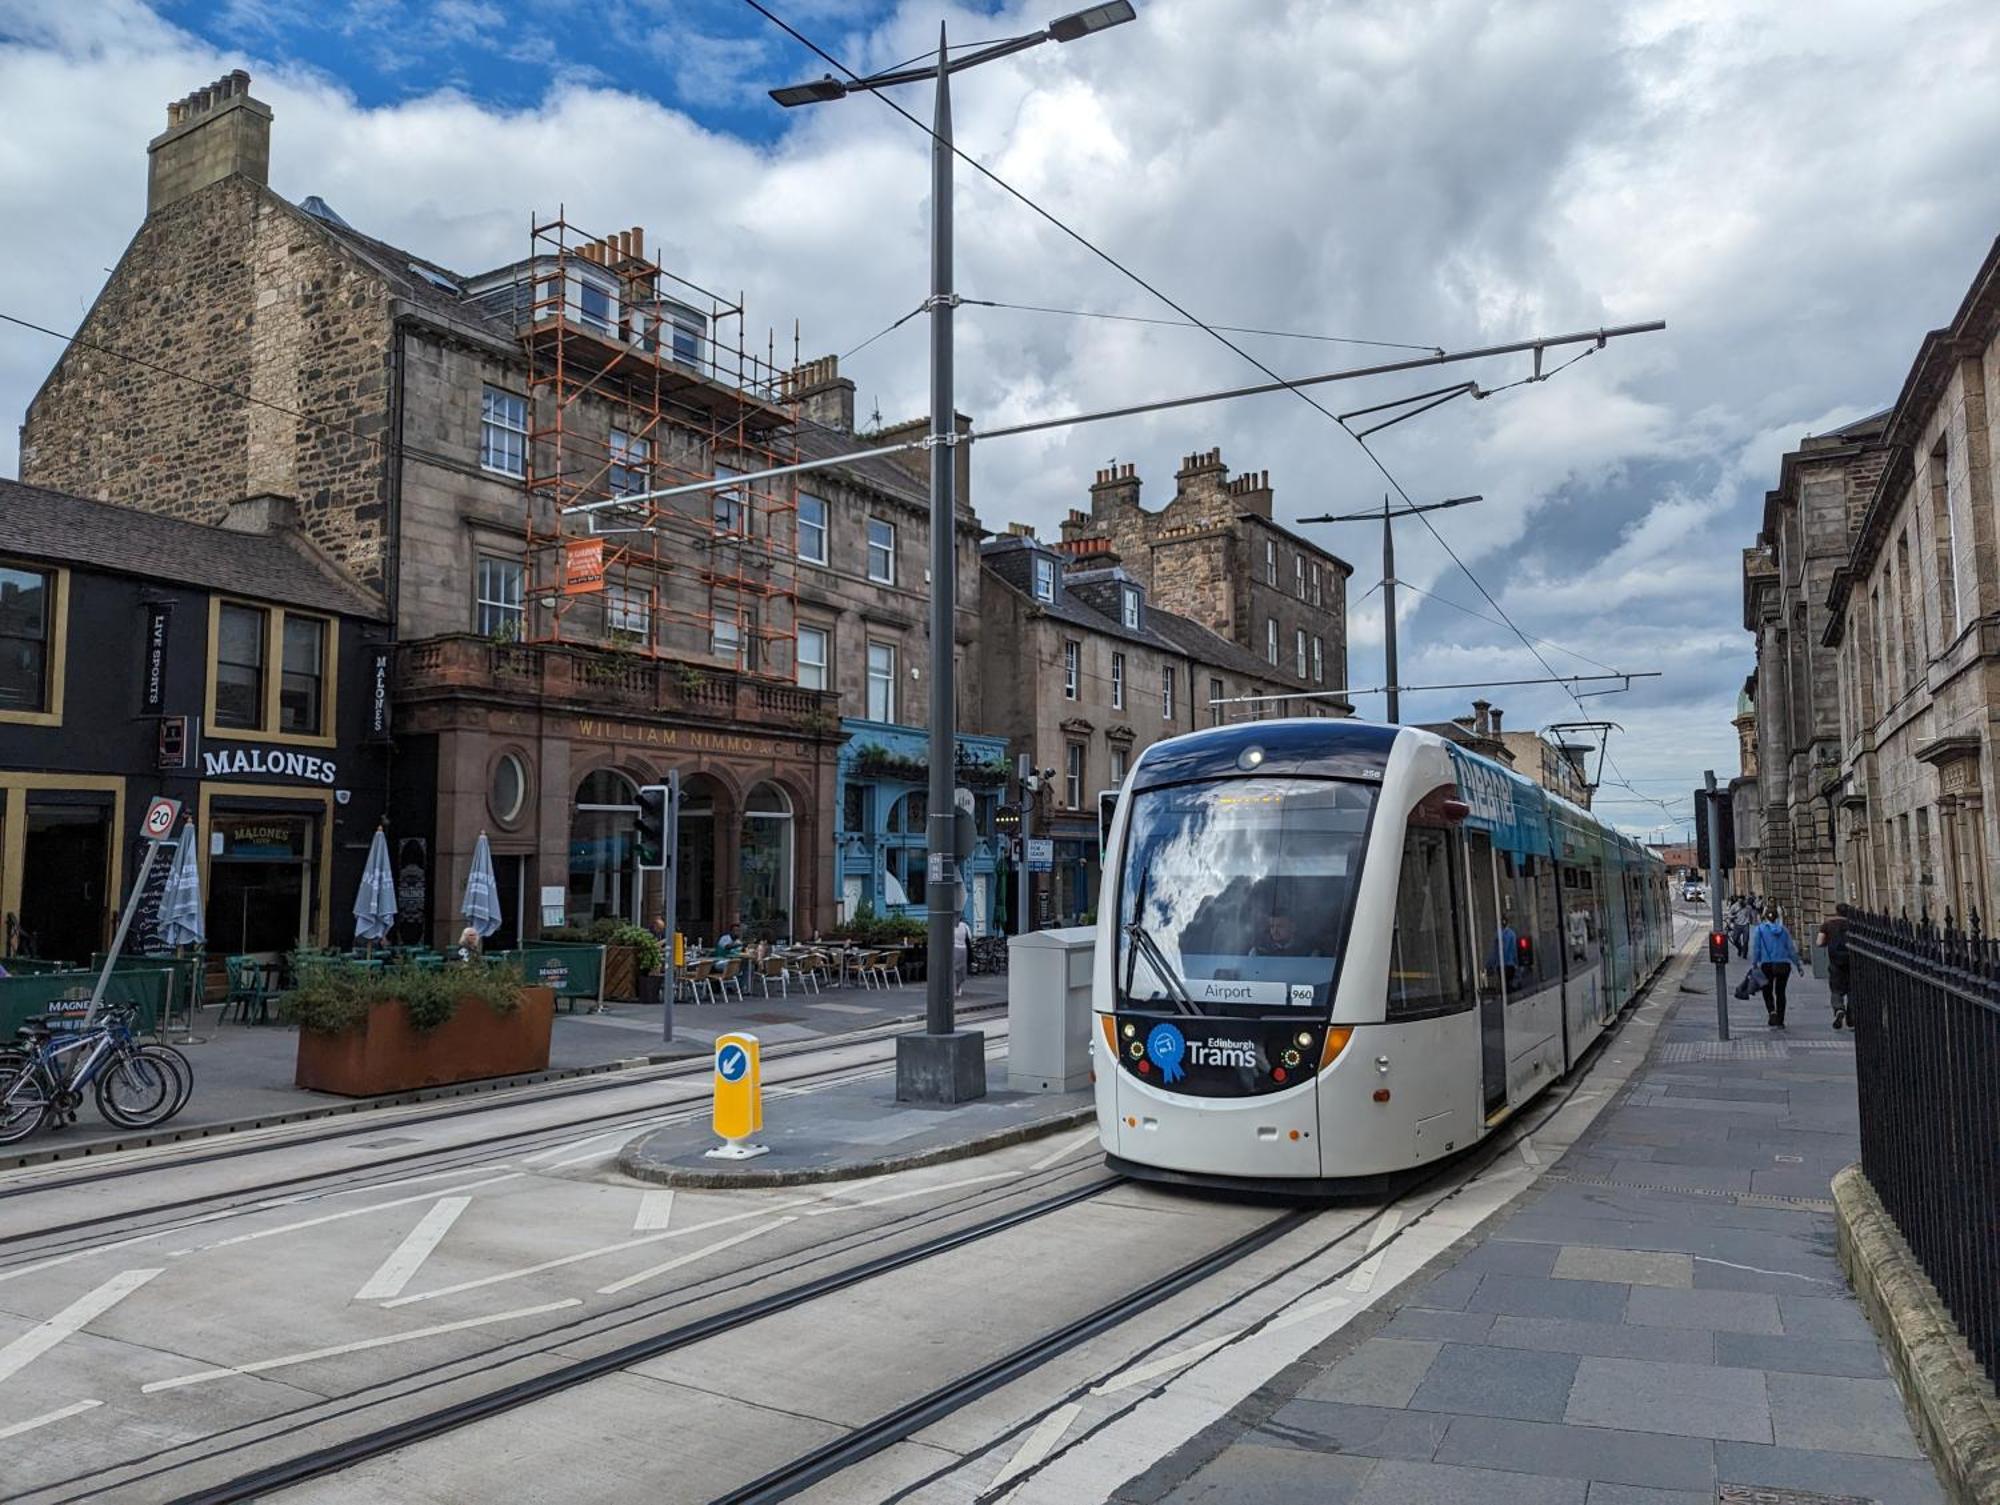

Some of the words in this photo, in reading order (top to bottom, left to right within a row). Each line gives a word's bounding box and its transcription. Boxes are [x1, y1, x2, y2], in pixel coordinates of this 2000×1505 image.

[153, 615, 164, 648] LIVE
[149, 649, 161, 704] SPORTS
[374, 655, 387, 732] MALONES
[579, 719, 677, 745] WILLIAM
[690, 732, 751, 752] NIMMO
[202, 749, 337, 784] MALONES
[151, 810, 170, 827] 20
[233, 827, 289, 841] MALONES
[1204, 984, 1252, 1000] Airport
[1292, 989, 1313, 1000] 960
[48, 999, 105, 1013] MAGNES
[1186, 1041, 1257, 1068] Trams
[1207, 1037, 1255, 1052] Edinburgh
